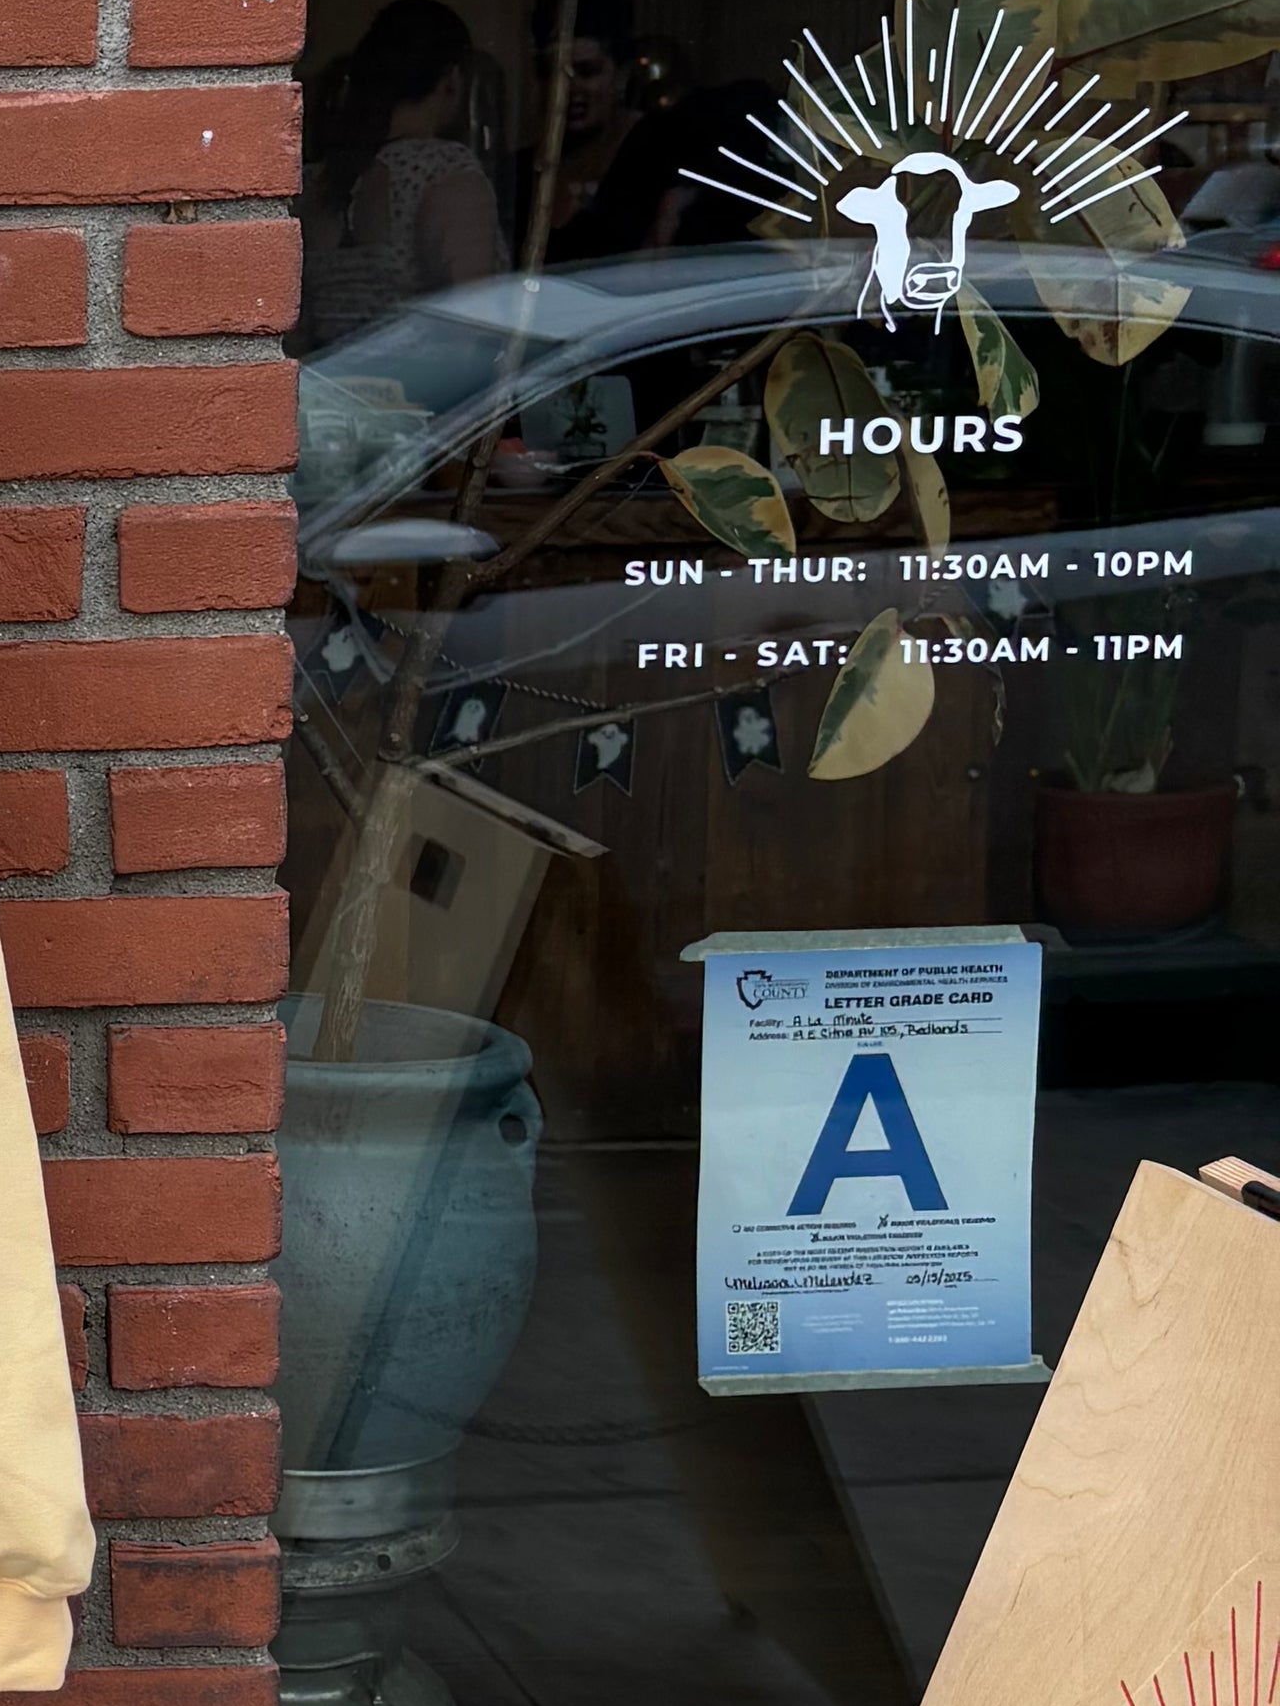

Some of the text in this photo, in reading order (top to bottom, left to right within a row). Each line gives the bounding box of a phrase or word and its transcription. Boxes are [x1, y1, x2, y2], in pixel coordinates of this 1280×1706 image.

[819, 414, 1025, 455] HOURS
[624, 559, 705, 586] SUN
[748, 556, 867, 585] THUR:
[898, 553, 1049, 581] 11:30AM
[1093, 550, 1194, 578] 10PM
[638, 642, 705, 669] FRI
[756, 640, 848, 667] SAT:
[899, 636, 1050, 664] 11:30AM
[1093, 634, 1184, 661] 11PM
[825, 964, 1003, 980] DEPARTMENT OF PUBLIC HEALTH
[825, 996, 885, 1010] LETTER
[889, 993, 944, 1007] GRADE
[948, 991, 993, 1005] CARD
[792, 1015, 802, 1026] A
[785, 1052, 950, 1217] A
